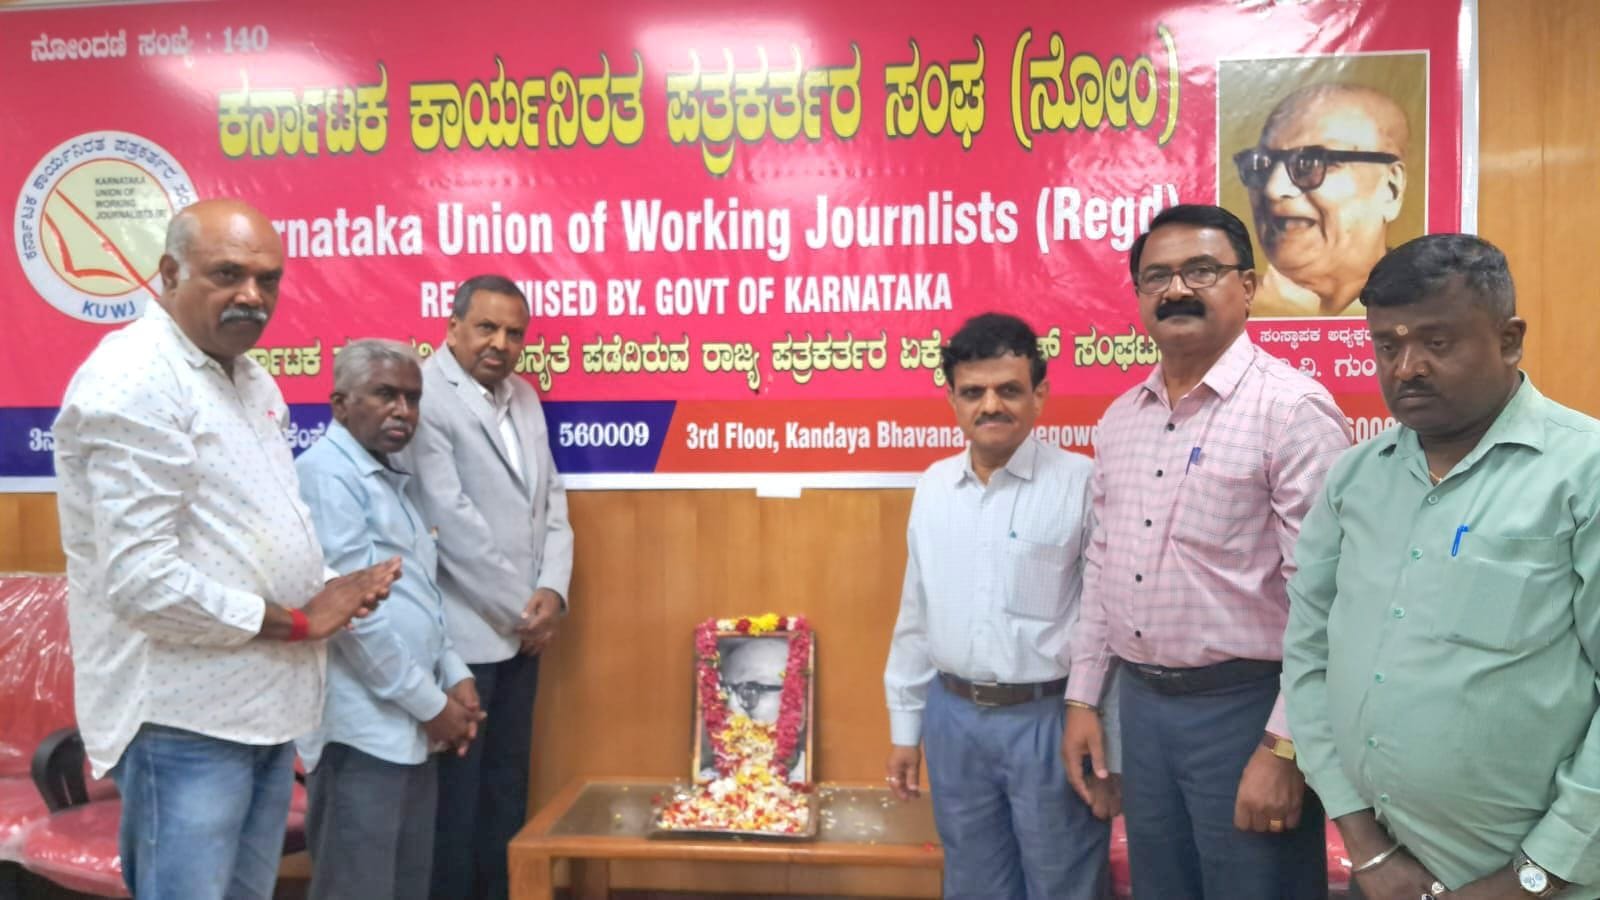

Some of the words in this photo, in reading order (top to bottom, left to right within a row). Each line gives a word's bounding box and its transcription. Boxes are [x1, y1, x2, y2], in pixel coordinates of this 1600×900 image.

[30, 29, 127, 61] ನೋಂದಣಿ
[138, 25, 195, 68] ಸಂಖ್ಯೆ
[223, 25, 269, 54] 140
[217, 60, 389, 159] ಕರ್ನಾಟಕ
[409, 51, 646, 151] ಕಾರ್ಯನಿರತ
[666, 40, 863, 177] ಪತ್ರಕರ್ತರ
[885, 35, 986, 151] ಸಂಘ
[1009, 24, 1181, 150] (ನೋಂ)
[95, 176, 145, 185] KARNATAKA
[271, 204, 423, 258] rnataka
[437, 202, 552, 255] Union
[568, 200, 608, 252] of
[621, 197, 791, 261] Working
[805, 191, 1018, 251] Journlists
[82, 300, 136, 319] KUWJ
[421, 280, 598, 318] RENISED
[607, 279, 646, 316] BY.
[655, 277, 730, 315] GOVT
[738, 275, 775, 314] OF
[784, 273, 953, 313] KARNATAKA
[582, 333, 690, 373] ಪಡೆದಿರುವ
[702, 339, 761, 390] ರಾಜ್ಯ
[772, 330, 888, 384] ಪತ್ರಕರ್ತರ
[559, 420, 650, 448] 560009
[686, 424, 719, 450] 3rd
[724, 423, 779, 454] Floor,
[785, 422, 870, 454] Kandaya
